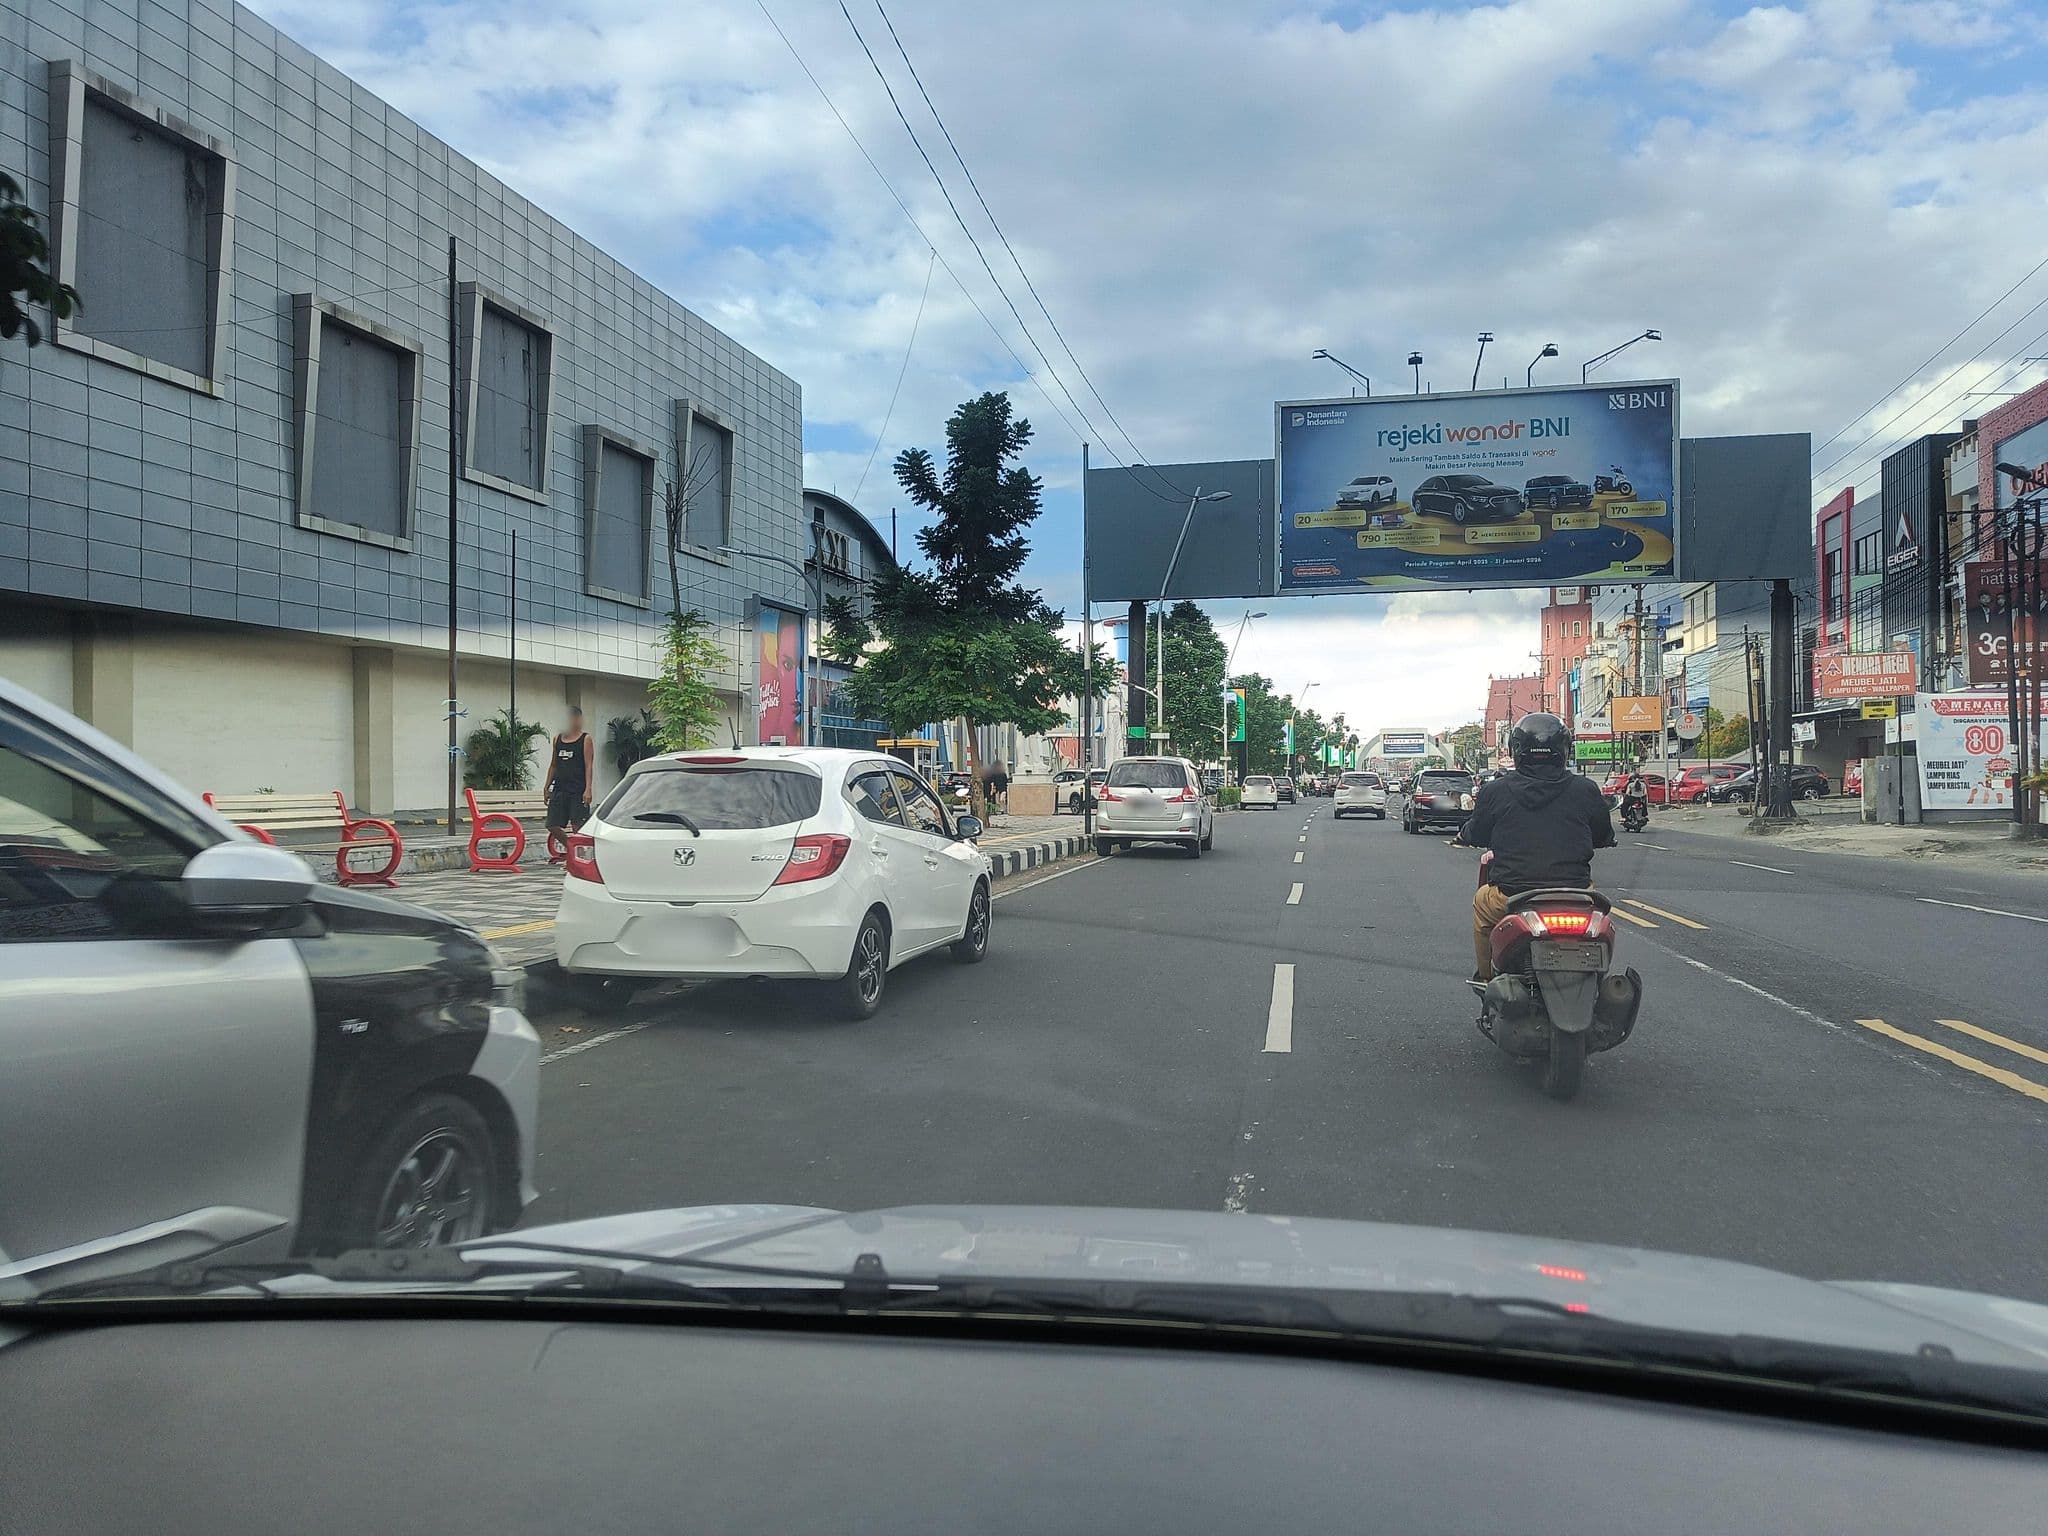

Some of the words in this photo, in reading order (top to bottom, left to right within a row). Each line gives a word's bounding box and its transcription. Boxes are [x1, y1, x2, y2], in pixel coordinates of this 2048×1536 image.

[1629, 392, 1667, 409] BNI
[1306, 410, 1347, 420] Danantara
[1306, 417, 1345, 426] Indonesia
[1377, 422, 1442, 451] rejeki
[1446, 419, 1526, 442] wondr
[1530, 416, 1570, 438] BNI
[1389, 456, 1410, 464] Makin
[1411, 455, 1433, 463] Sering
[1434, 453, 1461, 461] Tambah
[1461, 452, 1481, 460] Saldo
[1488, 450, 1520, 459] Transaksi
[1521, 449, 1529, 457] di
[1425, 462, 1446, 470] Makin
[1446, 461, 1467, 469] Besar
[1467, 460, 1495, 468] Peluang
[1496, 459, 1524, 467] Menang
[1610, 505, 1629, 515] 170
[1298, 515, 1311, 525] 20
[1556, 517, 1570, 526] 14
[1361, 534, 1381, 543] 790
[1471, 530, 1478, 540] 2
[1456, 558, 1472, 566] April
[1502, 557, 1525, 565] Januari
[1887, 546, 1919, 568] EIGER
[1842, 656, 1882, 676] MENARA
[1882, 654, 1910, 674] MEGA
[1840, 677, 1877, 687] MEUBEL
[1879, 676, 1897, 685] JATI
[1828, 686, 1851, 695] LAMPU
[1852, 686, 1867, 694] HIAS
[1872, 684, 1911, 693] WALLPAPER
[1965, 726, 2004, 755] 80
[1926, 761, 1949, 769] MEUBEL
[1926, 771, 1945, 780] LAMPU
[1946, 771, 1960, 779] HIAS
[1927, 782, 1946, 790] LAMPU
[1946, 782, 1971, 790] KRISTAL
